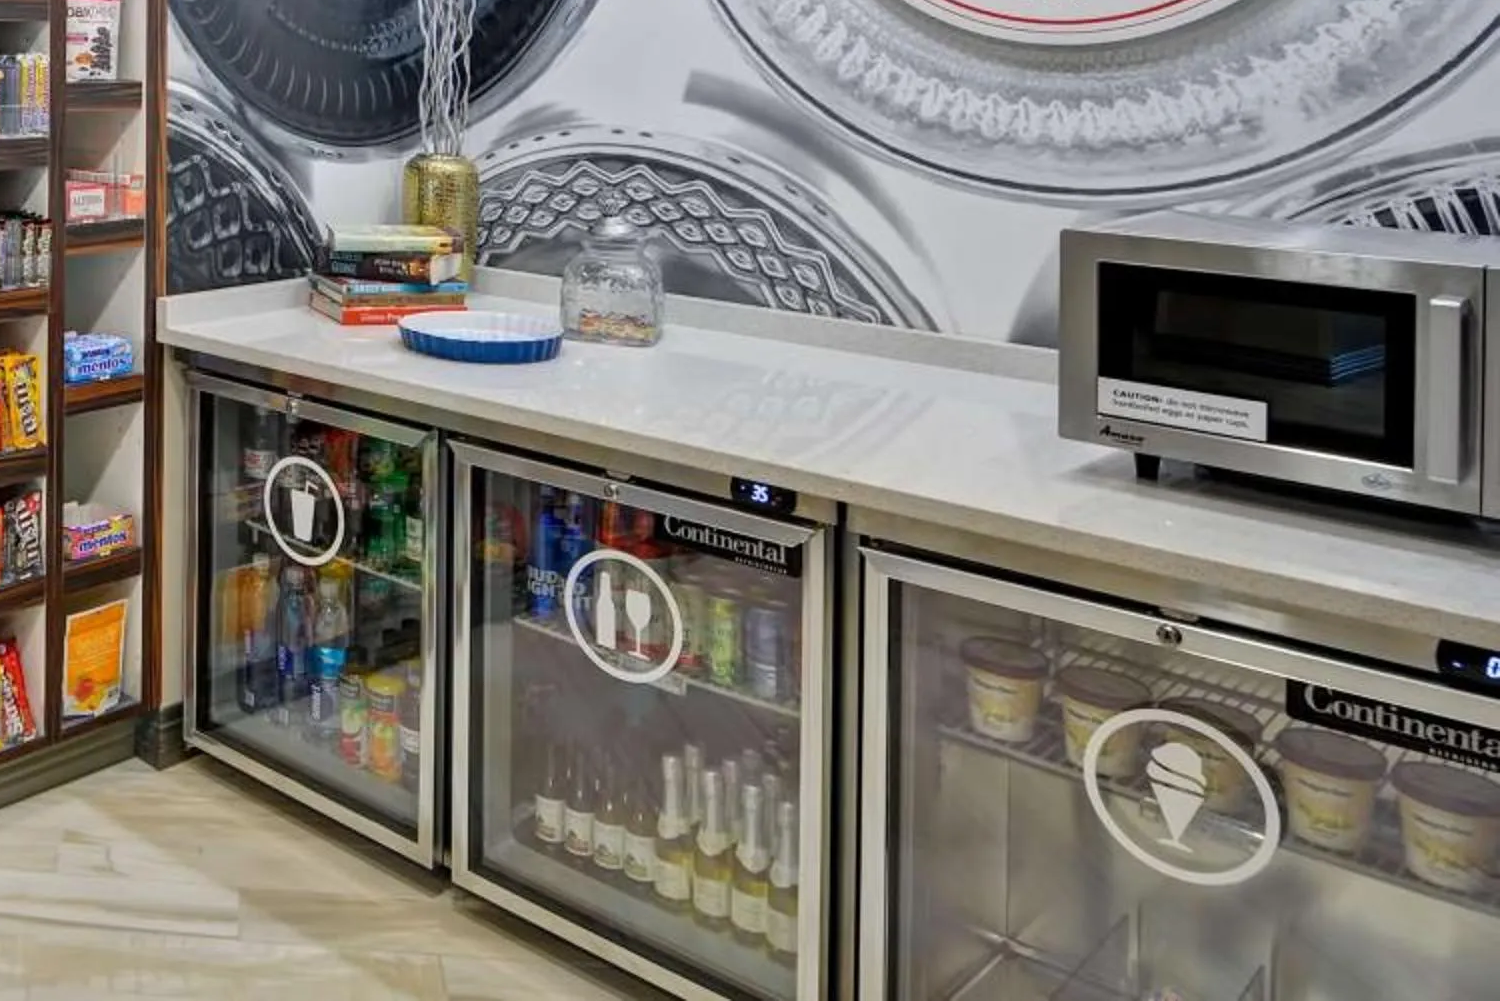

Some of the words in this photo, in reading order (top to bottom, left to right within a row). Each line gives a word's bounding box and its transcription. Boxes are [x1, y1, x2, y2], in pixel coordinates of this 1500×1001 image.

[1113, 389, 1163, 403] CAUTION:
[751, 484, 769, 503] 35
[663, 514, 787, 565] Continental
[1304, 684, 1500, 759] Continenta
